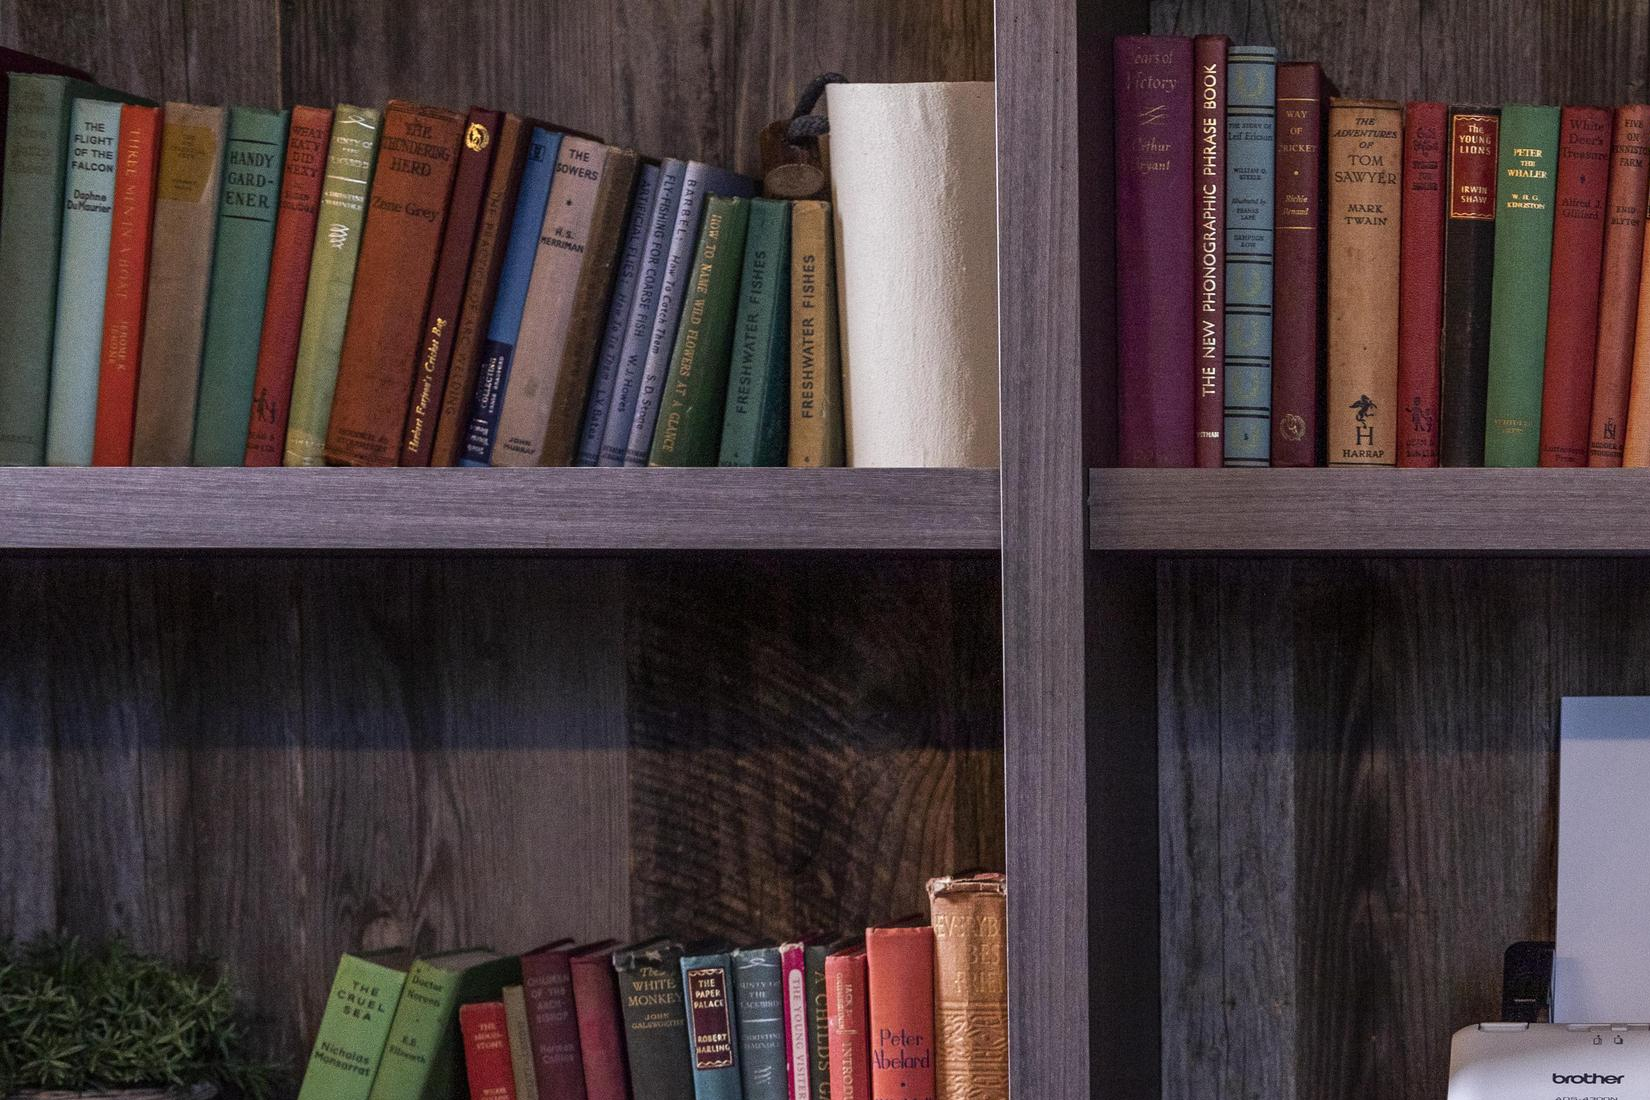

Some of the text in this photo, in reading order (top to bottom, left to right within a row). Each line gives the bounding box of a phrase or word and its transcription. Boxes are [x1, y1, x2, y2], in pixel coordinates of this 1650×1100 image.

[1285, 110, 1308, 119] WAY
[85, 122, 105, 132] THE
[1356, 117, 1376, 126] THE
[1569, 119, 1605, 131] White
[1624, 119, 1644, 129] FIVE
[1289, 127, 1303, 136] OF
[1333, 129, 1398, 139] ADVENTURES
[1468, 125, 1484, 134] The
[74, 134, 114, 146] FLIGHT
[1459, 135, 1492, 145] YOUNG
[1627, 133, 1640, 142] ON
[382, 136, 449, 162] THUNDERING
[1278, 145, 1317, 153] CRICKET
[1359, 141, 1374, 149] OF
[1459, 145, 1491, 155] LIONS
[74, 148, 114, 160] OF THE
[292, 152, 314, 164] DID
[569, 148, 590, 162] THE
[1563, 147, 1609, 160] Treasure
[71, 161, 114, 173] FALCON
[230, 153, 274, 168] HANDY
[391, 157, 432, 177] HERD
[1348, 155, 1384, 167] TOM
[1619, 158, 1643, 168] FARM
[556, 162, 598, 181] SOWERS
[1506, 169, 1547, 179] WHALER
[228, 171, 274, 186] GARD-
[1335, 171, 1397, 186] SAWYER
[73, 189, 107, 202] Daphne
[1460, 186, 1487, 194] IRWIN
[225, 191, 270, 209] ENER
[1460, 195, 1488, 204] SHAW
[371, 196, 402, 212] Zane
[404, 202, 440, 222] Grey
[652, 174, 676, 239] FLY-FISHING
[1347, 204, 1384, 214] MARK
[1344, 216, 1388, 226] TWAIN
[1201, 63, 1217, 396] THE NEW PHONOGRAPHIC PHRASE BOOK
[541, 237, 584, 253] MERRIMAN
[647, 241, 662, 264] FOR
[638, 267, 656, 309] COARSE
[632, 313, 647, 337] FISH
[732, 248, 768, 414] FRESHWATER FISHES
[661, 213, 722, 453] HOW TO NAME WILD FLOWERS AT A GLANCE
[801, 253, 815, 418] FRESHWATER FISHES
[616, 377, 633, 413] Howes
[1342, 449, 1384, 459] HARRAP
[698, 979, 715, 988] THE
[812, 970, 825, 984] A
[352, 980, 380, 997] THE
[632, 978, 677, 991] WHITE
[628, 992, 683, 1007] MONKEY
[695, 988, 721, 998] PAPER
[337, 990, 386, 1013] CRUEL
[694, 999, 725, 1009] PALACE
[342, 1002, 372, 1021] SEA
[880, 1028, 924, 1046] Peter
[321, 1041, 370, 1065] Nicholas
[874, 1050, 930, 1069] Abelard
[1552, 1073, 1625, 1084] brother
